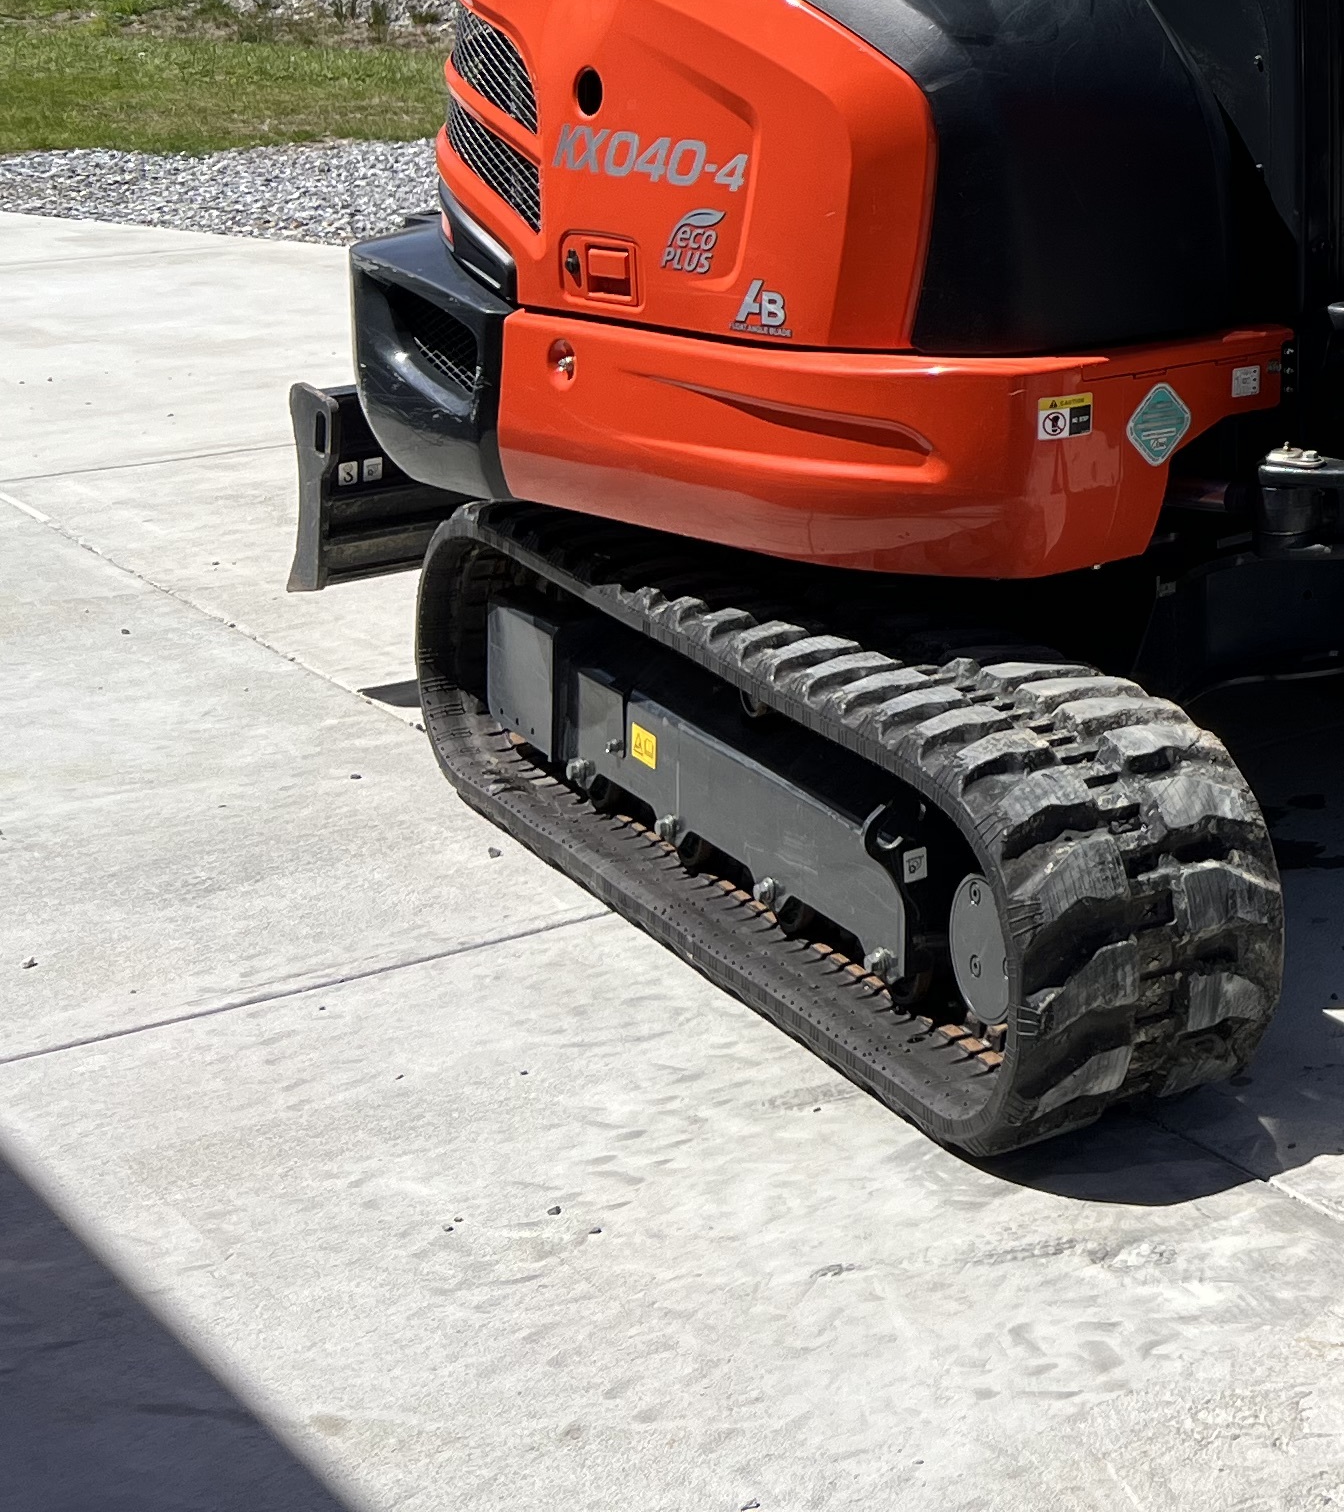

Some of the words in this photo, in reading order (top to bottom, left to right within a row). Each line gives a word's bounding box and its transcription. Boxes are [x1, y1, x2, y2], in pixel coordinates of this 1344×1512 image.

[552, 123, 749, 192] KX040-4
[676, 226, 717, 250] eco
[661, 246, 713, 274] PLUS
